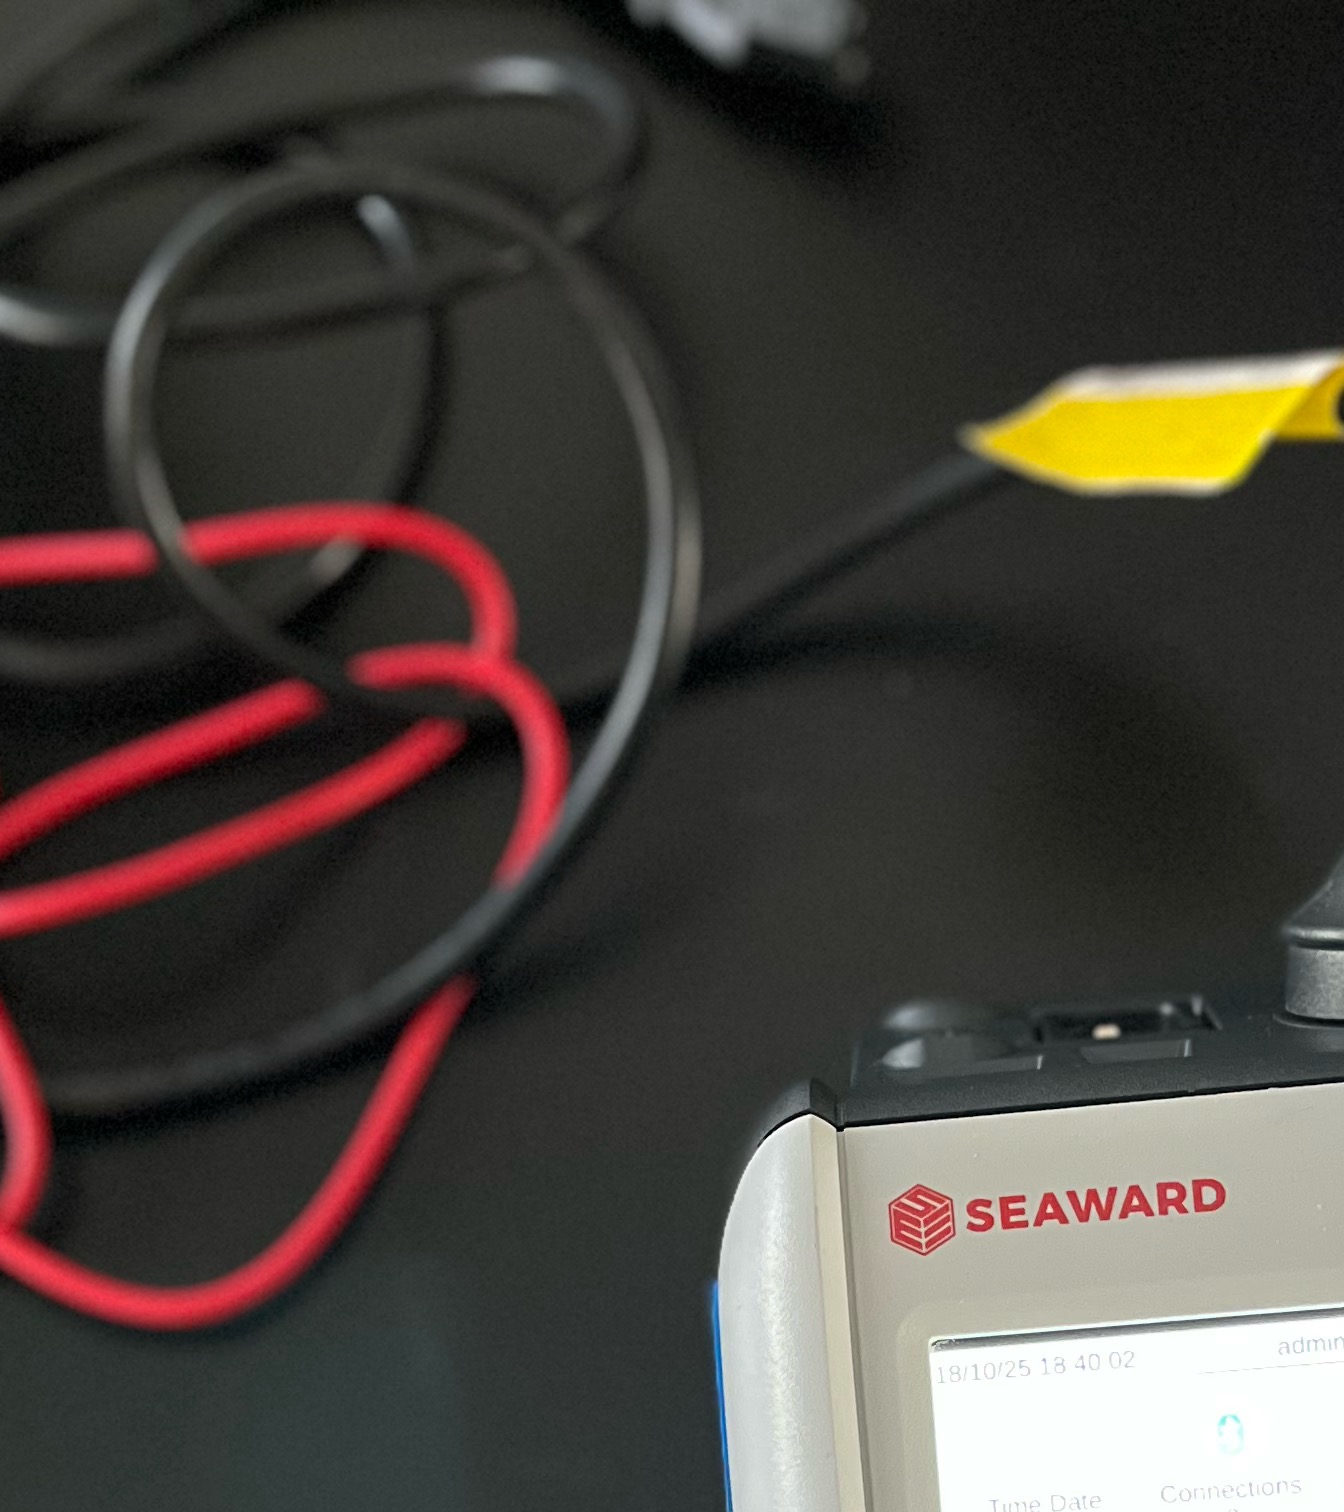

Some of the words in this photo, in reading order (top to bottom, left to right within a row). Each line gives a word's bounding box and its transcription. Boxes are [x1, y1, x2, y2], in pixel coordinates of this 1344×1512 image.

[965, 1178, 1227, 1234] SEAWARD
[936, 1358, 1031, 1385] 18/10/25
[1050, 1493, 1104, 1512] Date
[1160, 1476, 1303, 1505] Connections
